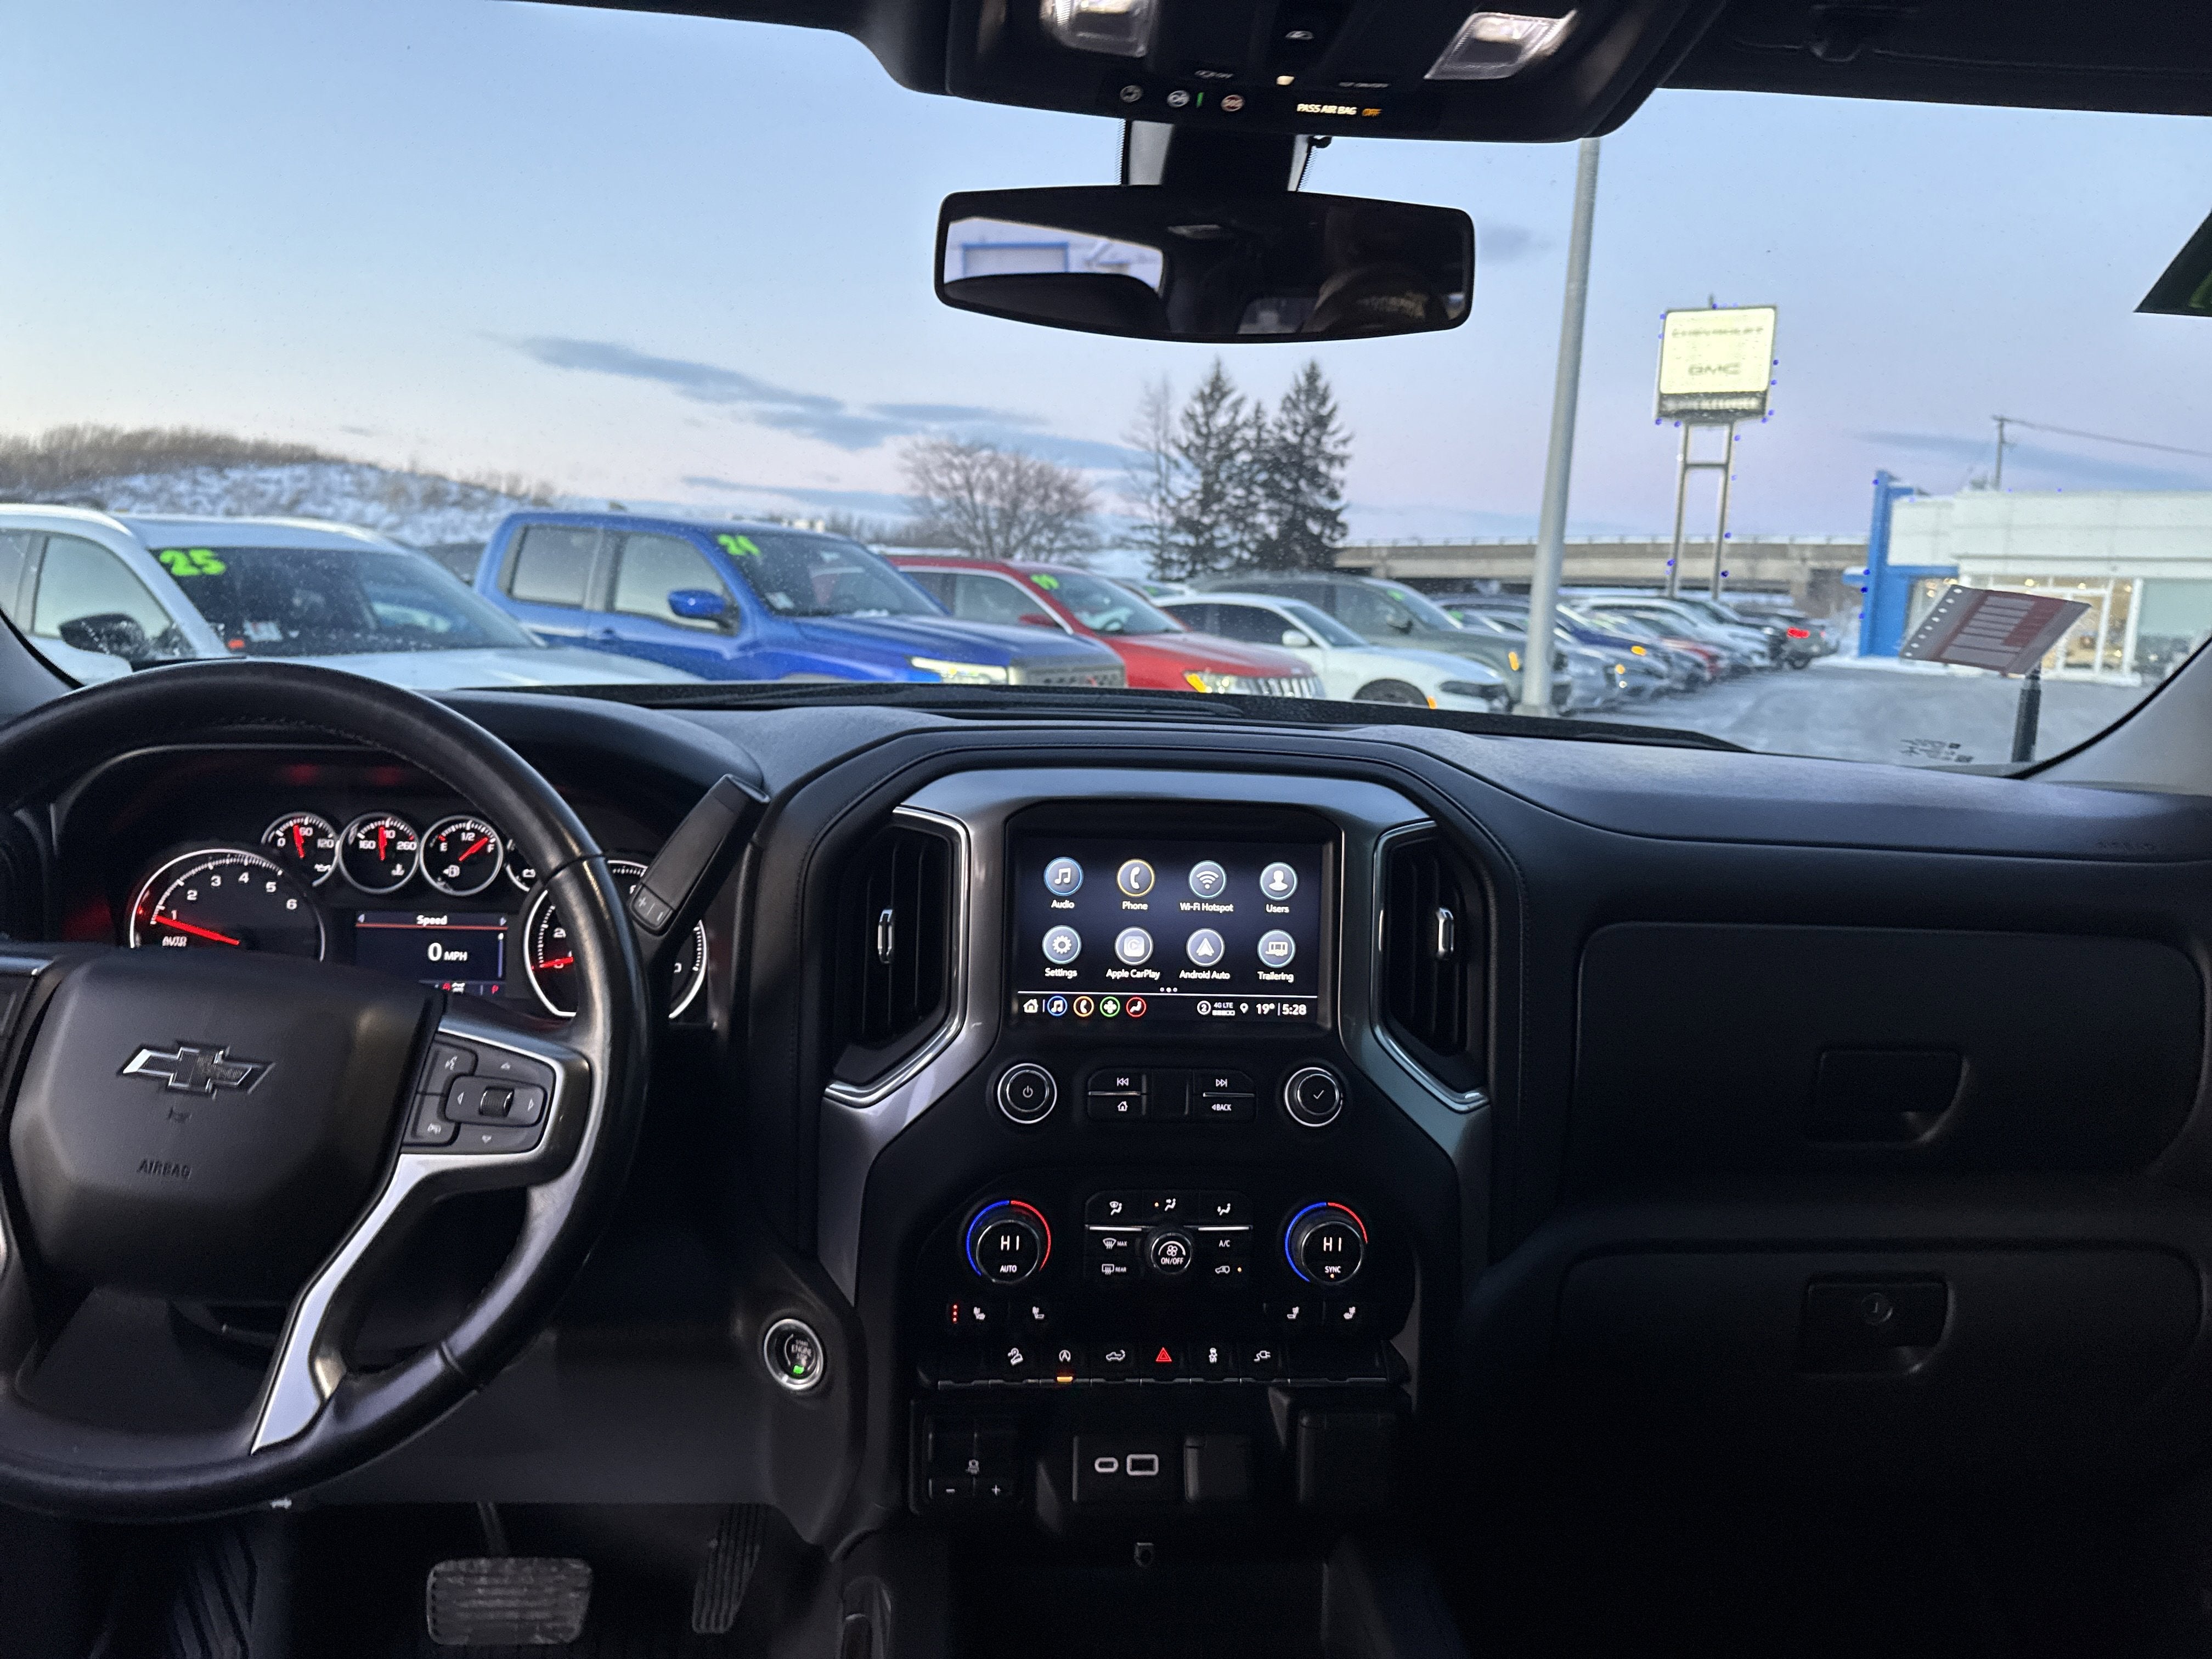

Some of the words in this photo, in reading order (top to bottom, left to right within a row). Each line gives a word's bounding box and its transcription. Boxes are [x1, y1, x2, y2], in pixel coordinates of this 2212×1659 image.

[1297, 104, 1321, 112] PASS
[1321, 105, 1337, 114] AIR
[1688, 363, 1741, 376] GMC
[159, 549, 227, 576] 25
[461, 832, 475, 841] 1/2
[276, 838, 285, 847] 0
[317, 839, 334, 848] 120
[359, 840, 376, 849] 160
[397, 841, 417, 850] 260
[440, 843, 448, 851] E
[487, 843, 494, 853] F
[211, 875, 221, 887] 3
[238, 872, 249, 883] 4
[266, 881, 276, 892] 5
[187, 889, 198, 900] 2
[286, 899, 297, 910] 6
[1051, 900, 1075, 909] Audio
[1122, 901, 1148, 910] Phone
[1180, 902, 1200, 911] Wi-Fi
[1201, 903, 1234, 913] Hotspot
[1266, 904, 1289, 913] Users
[170, 909, 177, 919] 1
[416, 915, 448, 926] Speed
[428, 943, 442, 961] 0
[443, 951, 467, 961] MPH
[1045, 968, 1077, 979] Settings
[1106, 969, 1129, 979] Apple
[1130, 969, 1160, 980] CarPlay
[1180, 970, 1210, 979] Android
[1211, 970, 1230, 979] Auto
[1257, 972, 1294, 983] Trailering
[1282, 1004, 1307, 1015] 5:28
[136, 1159, 193, 1179] AIRBAG
[1000, 1265, 1017, 1273] AUTO
